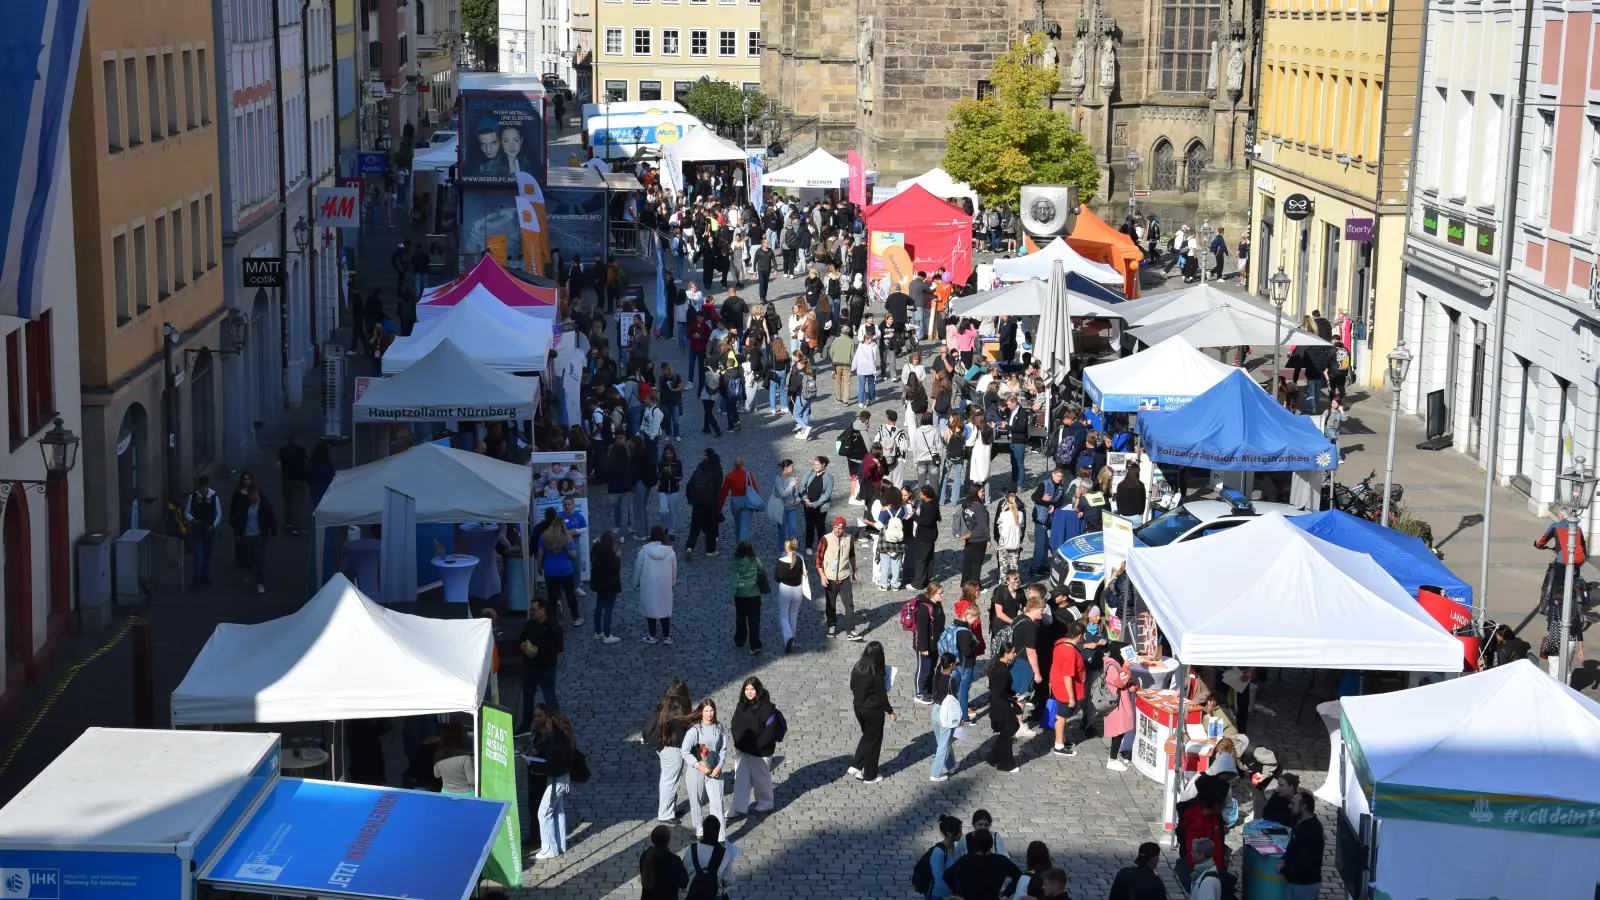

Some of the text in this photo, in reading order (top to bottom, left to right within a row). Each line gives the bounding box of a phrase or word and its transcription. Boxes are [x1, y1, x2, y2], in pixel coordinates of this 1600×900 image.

[321, 195, 355, 219] H&M
[1346, 224, 1372, 234] liberty
[246, 261, 281, 273] MATT
[250, 274, 277, 284] optik
[368, 406, 516, 419] Hauptzollamt Nürnberg
[1157, 446, 1310, 463] Polizeipräsidium Mittelfranken
[31, 873, 57, 885] IHK
[328, 861, 359, 888] JETZT
